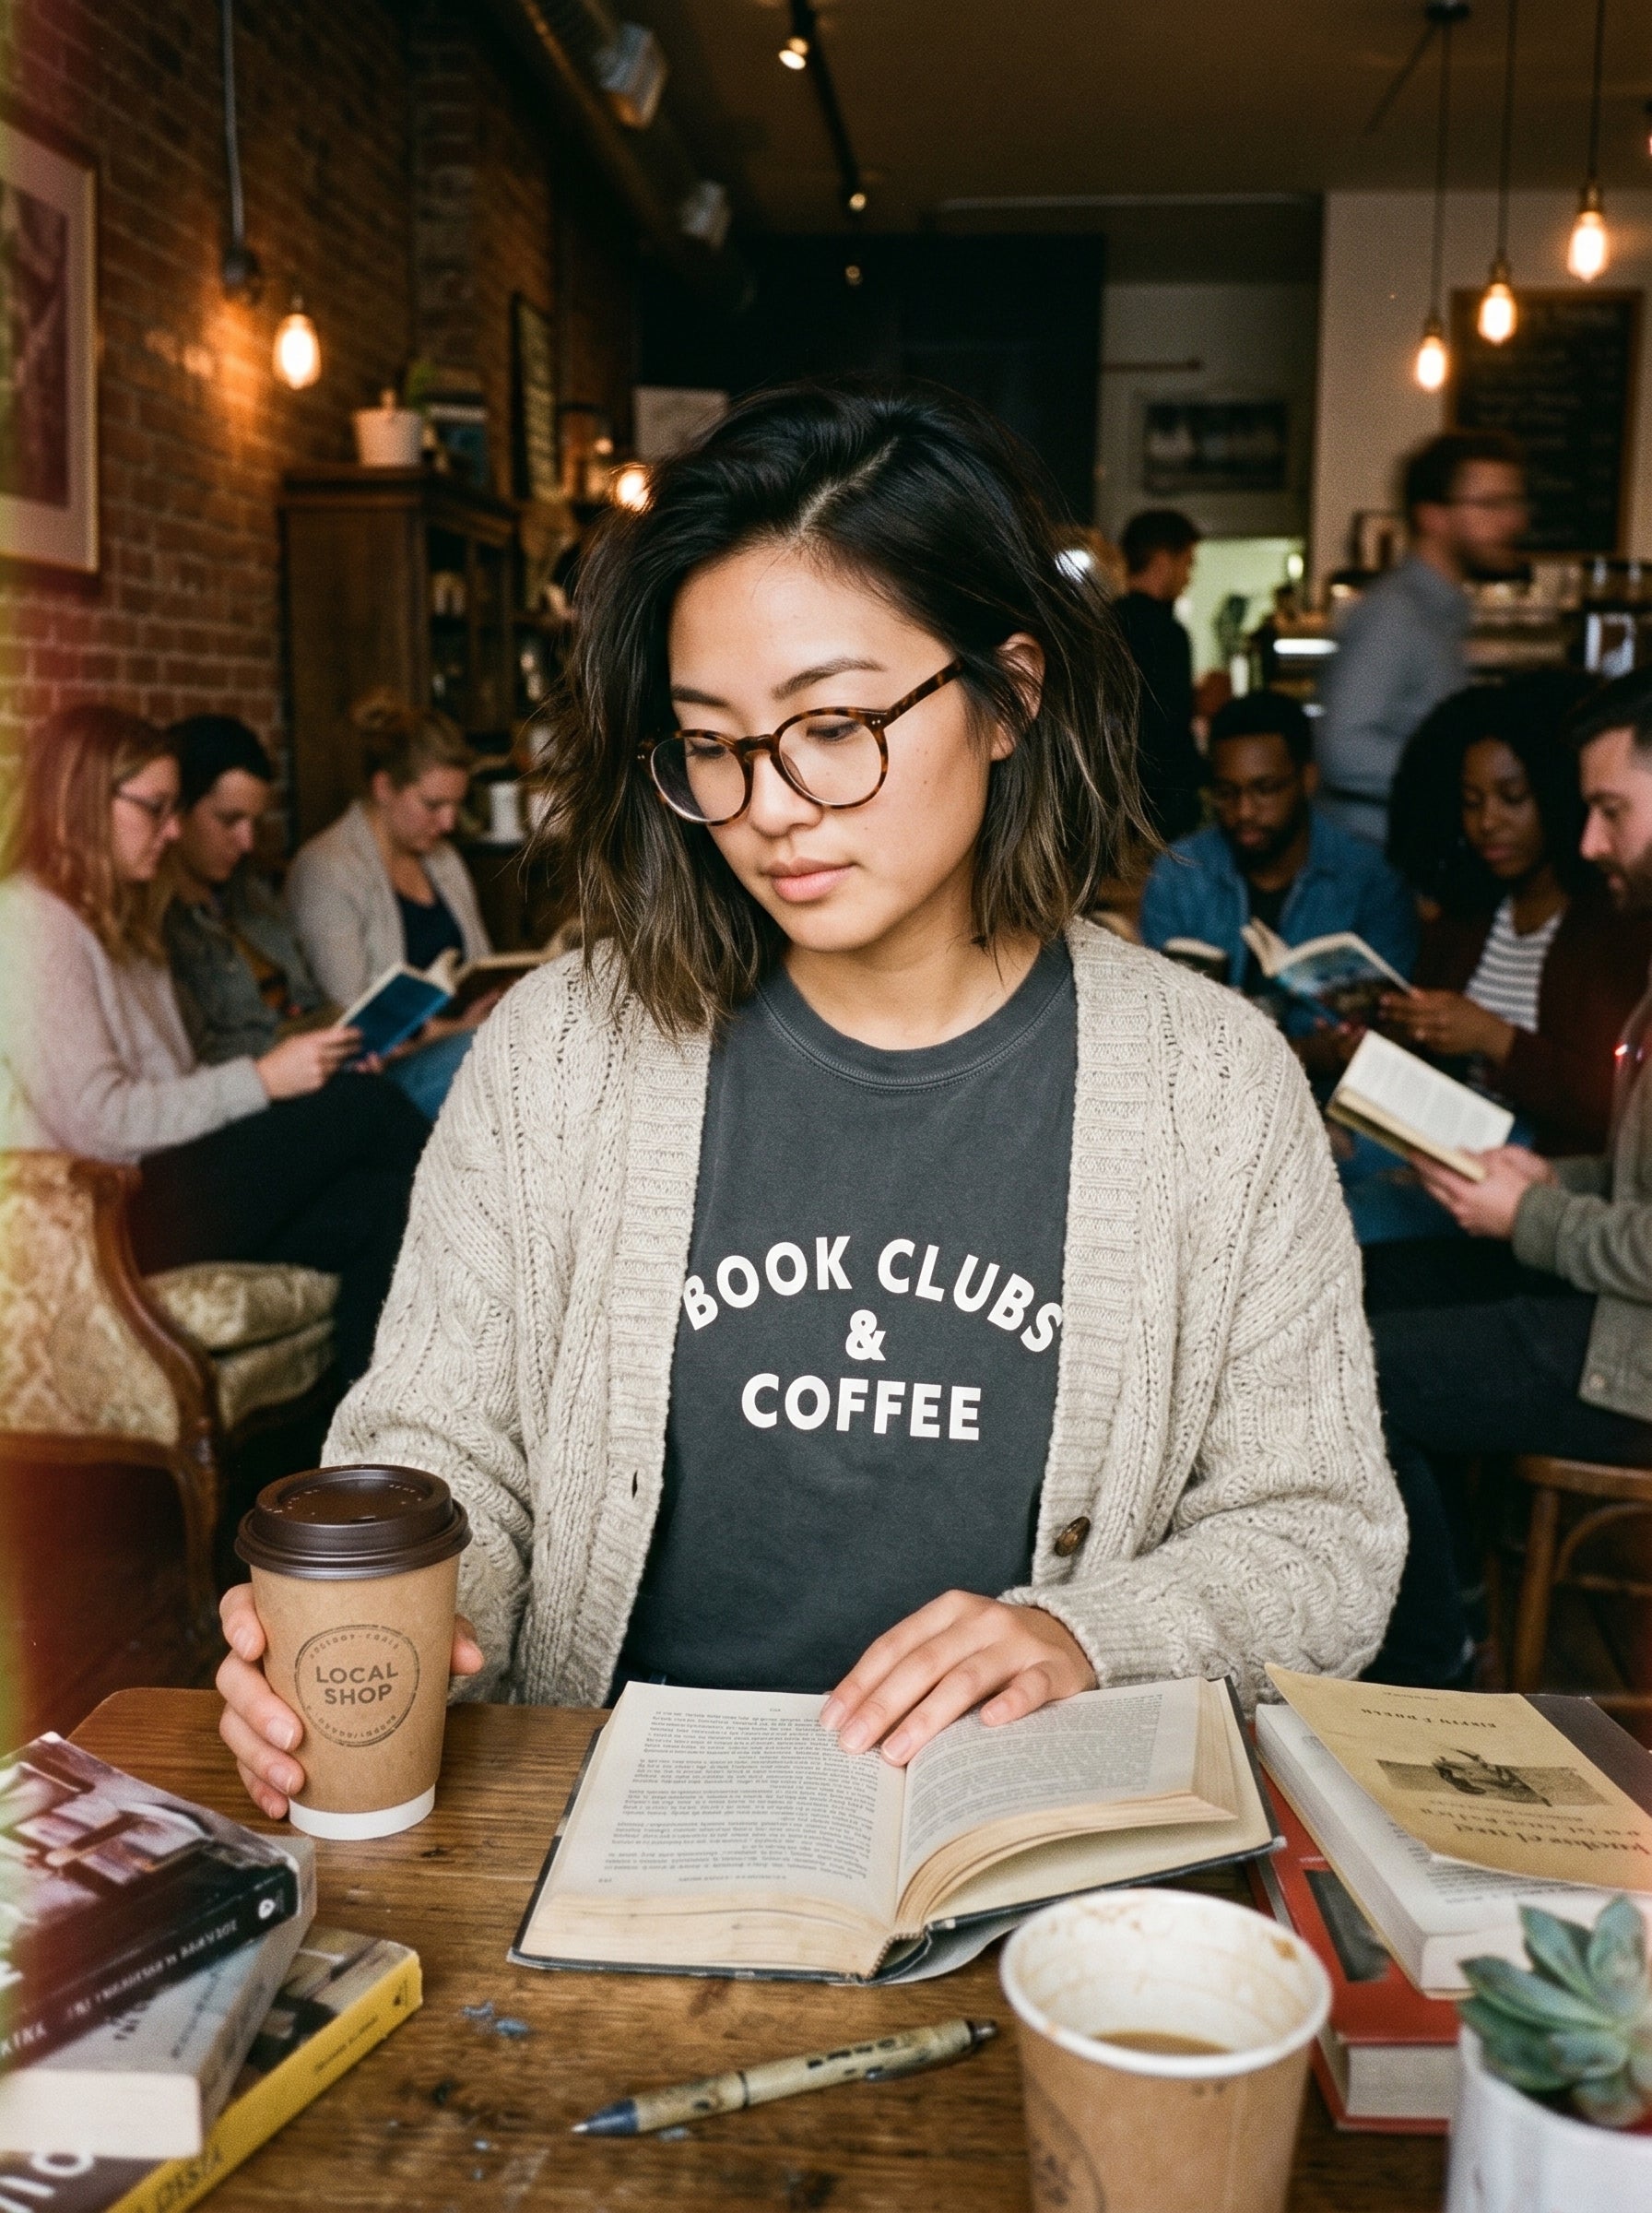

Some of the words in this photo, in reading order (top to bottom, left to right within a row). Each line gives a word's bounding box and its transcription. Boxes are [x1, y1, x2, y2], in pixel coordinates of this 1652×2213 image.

[683, 1236, 853, 1331] BOOK
[876, 1238, 1063, 1353] CLUBS
[845, 1309, 886, 1361] &
[742, 1373, 982, 1440] COFFEE
[315, 1662, 399, 1685] LOCAL
[324, 1683, 393, 1706] SHOP
